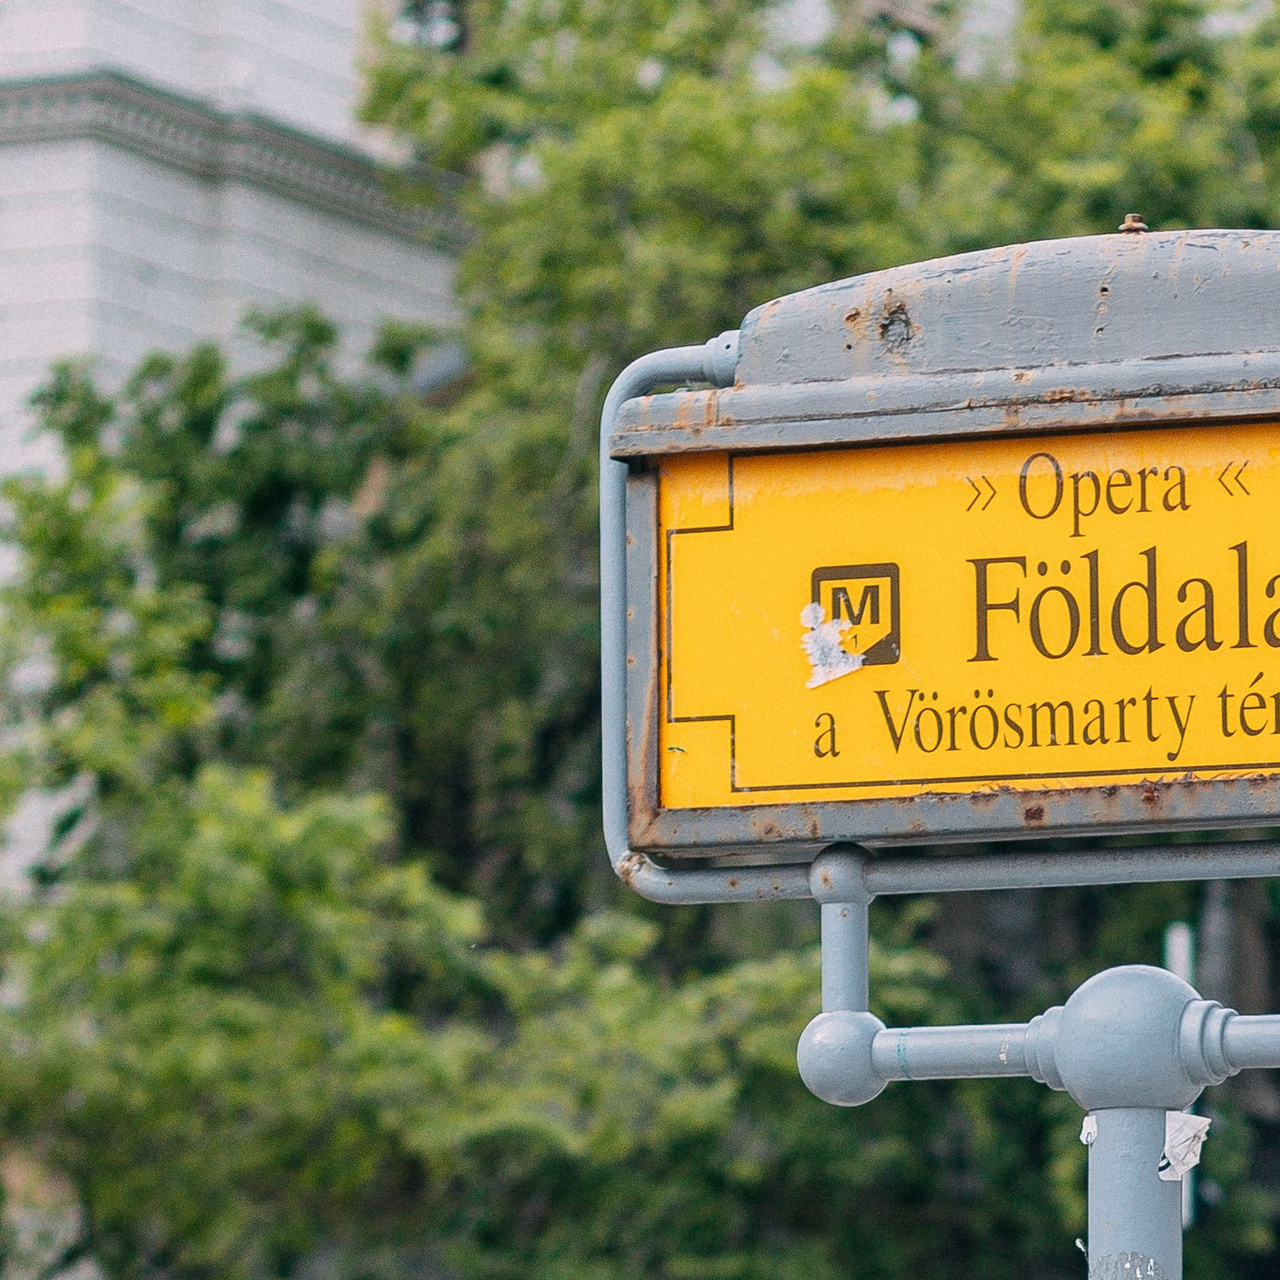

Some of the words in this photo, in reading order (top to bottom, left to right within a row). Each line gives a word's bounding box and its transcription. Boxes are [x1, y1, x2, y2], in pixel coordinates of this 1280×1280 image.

[1018, 452, 1192, 538] Opera
[831, 585, 880, 625] M
[813, 712, 841, 759] a
[874, 684, 1196, 761] Vörösmarty
